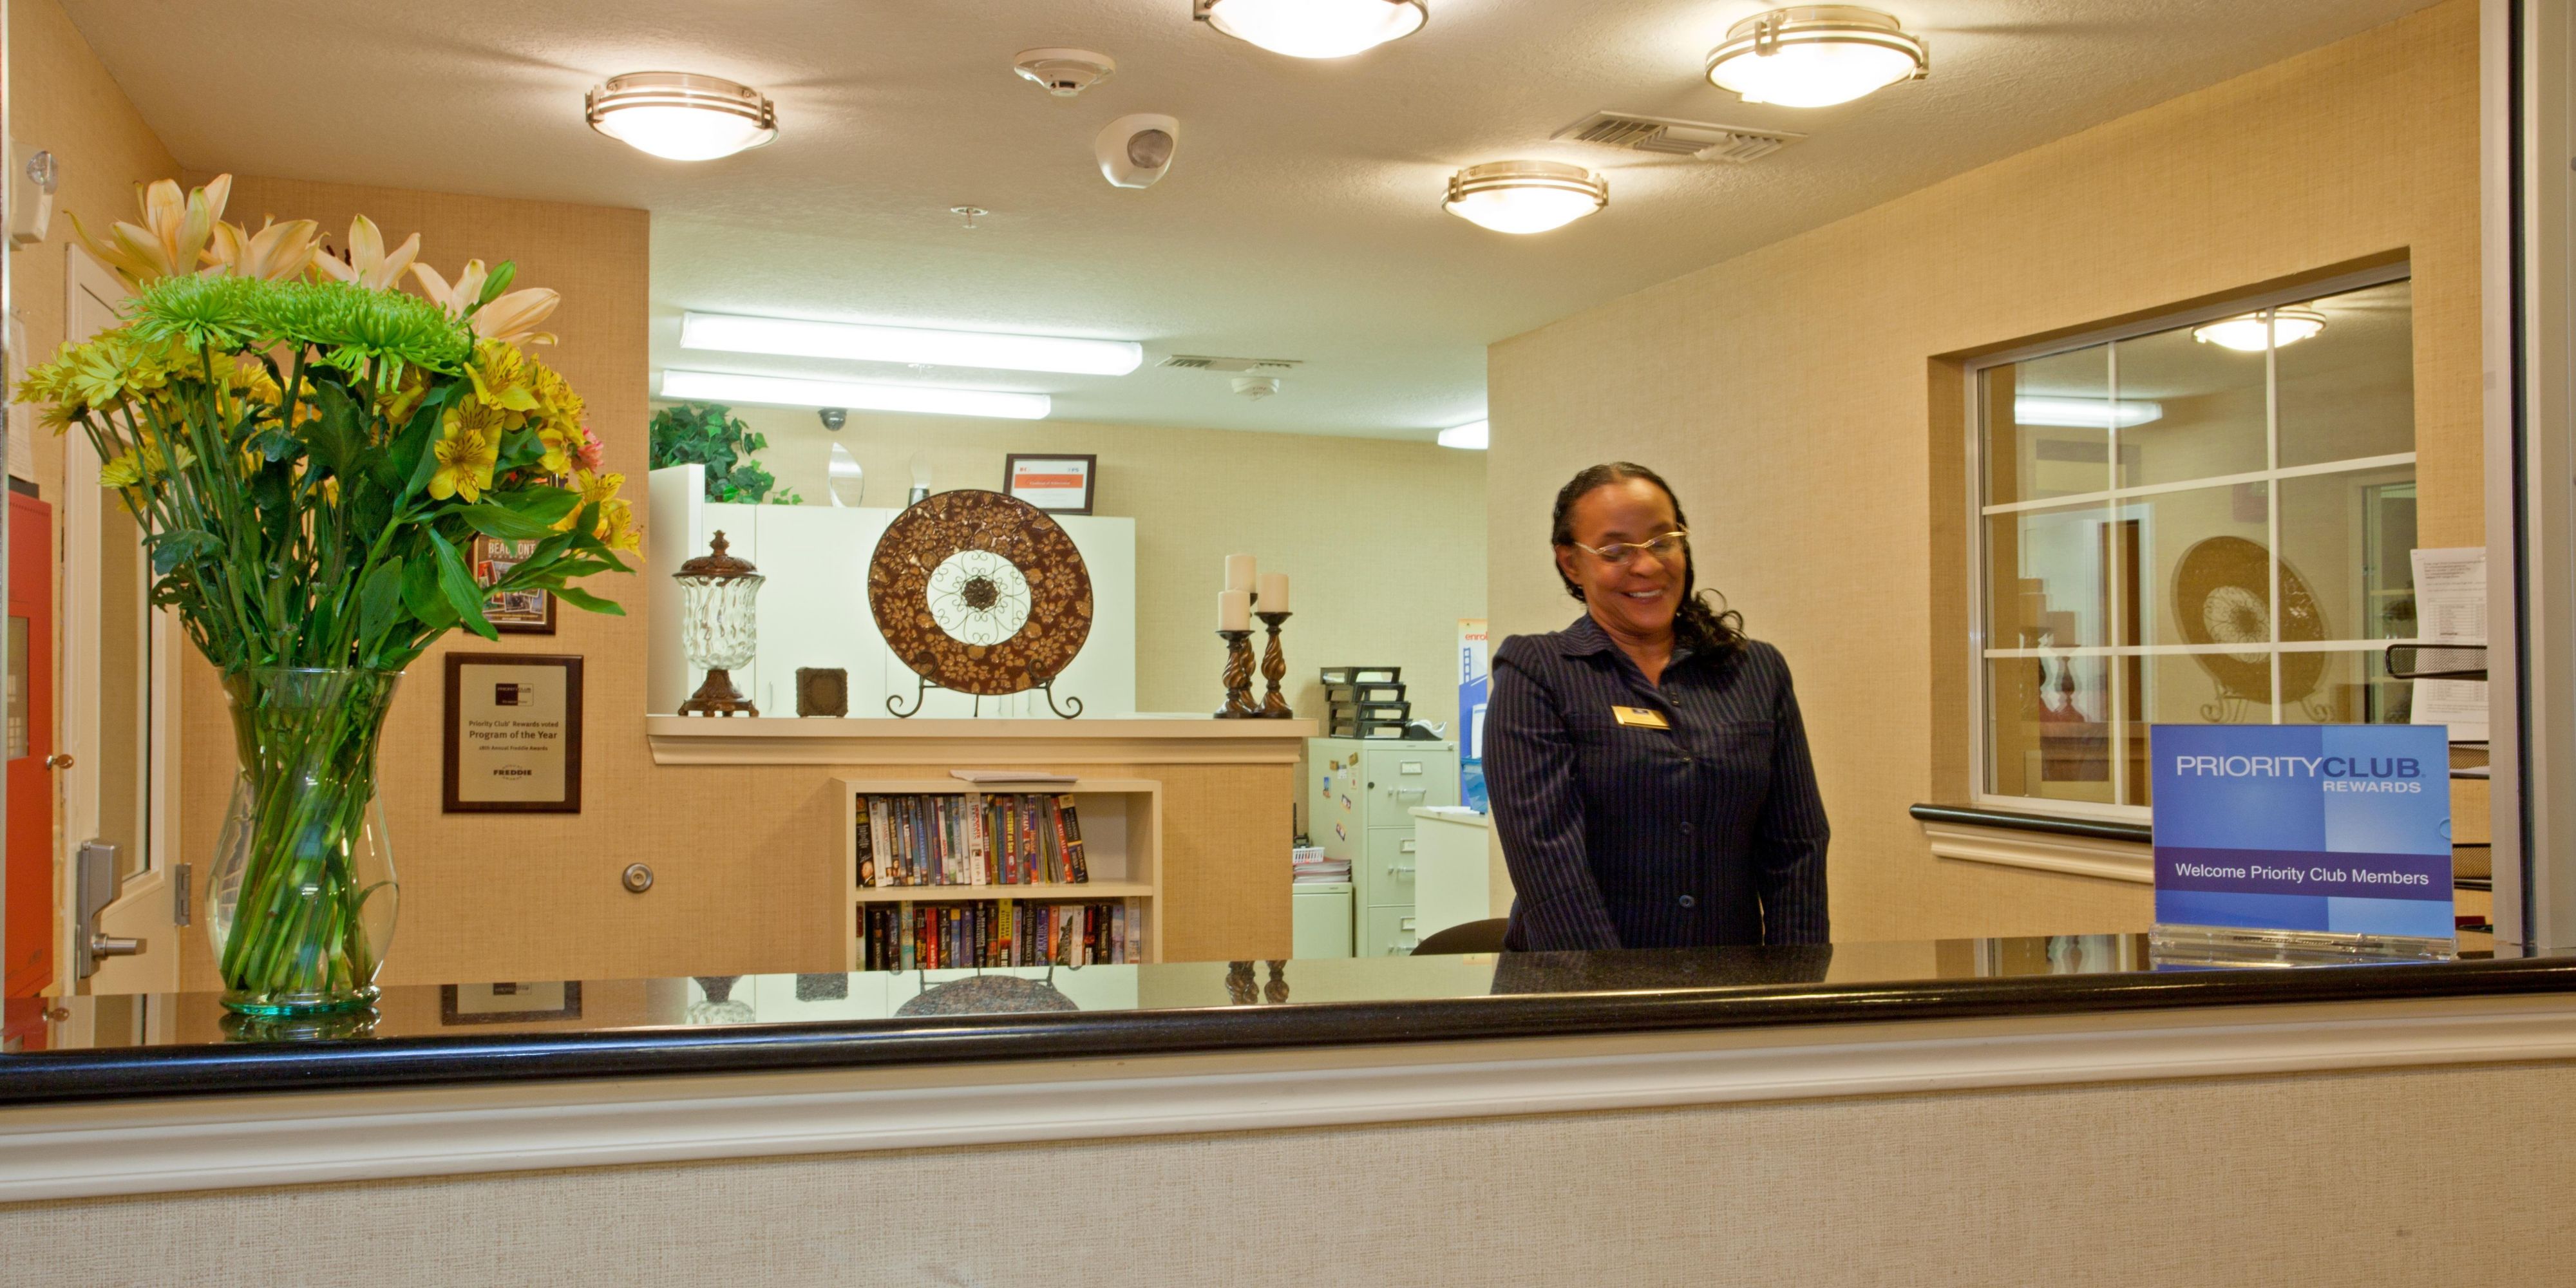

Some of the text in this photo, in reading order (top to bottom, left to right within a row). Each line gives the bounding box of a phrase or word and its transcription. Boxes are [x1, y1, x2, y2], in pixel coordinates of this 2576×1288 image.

[489, 542, 536, 554] BEAUONT
[469, 730, 507, 740] Program
[509, 730, 519, 739] of
[2323, 781, 2421, 793] REWARDS
[2175, 863, 2429, 886] Welcome Priority Club Members
